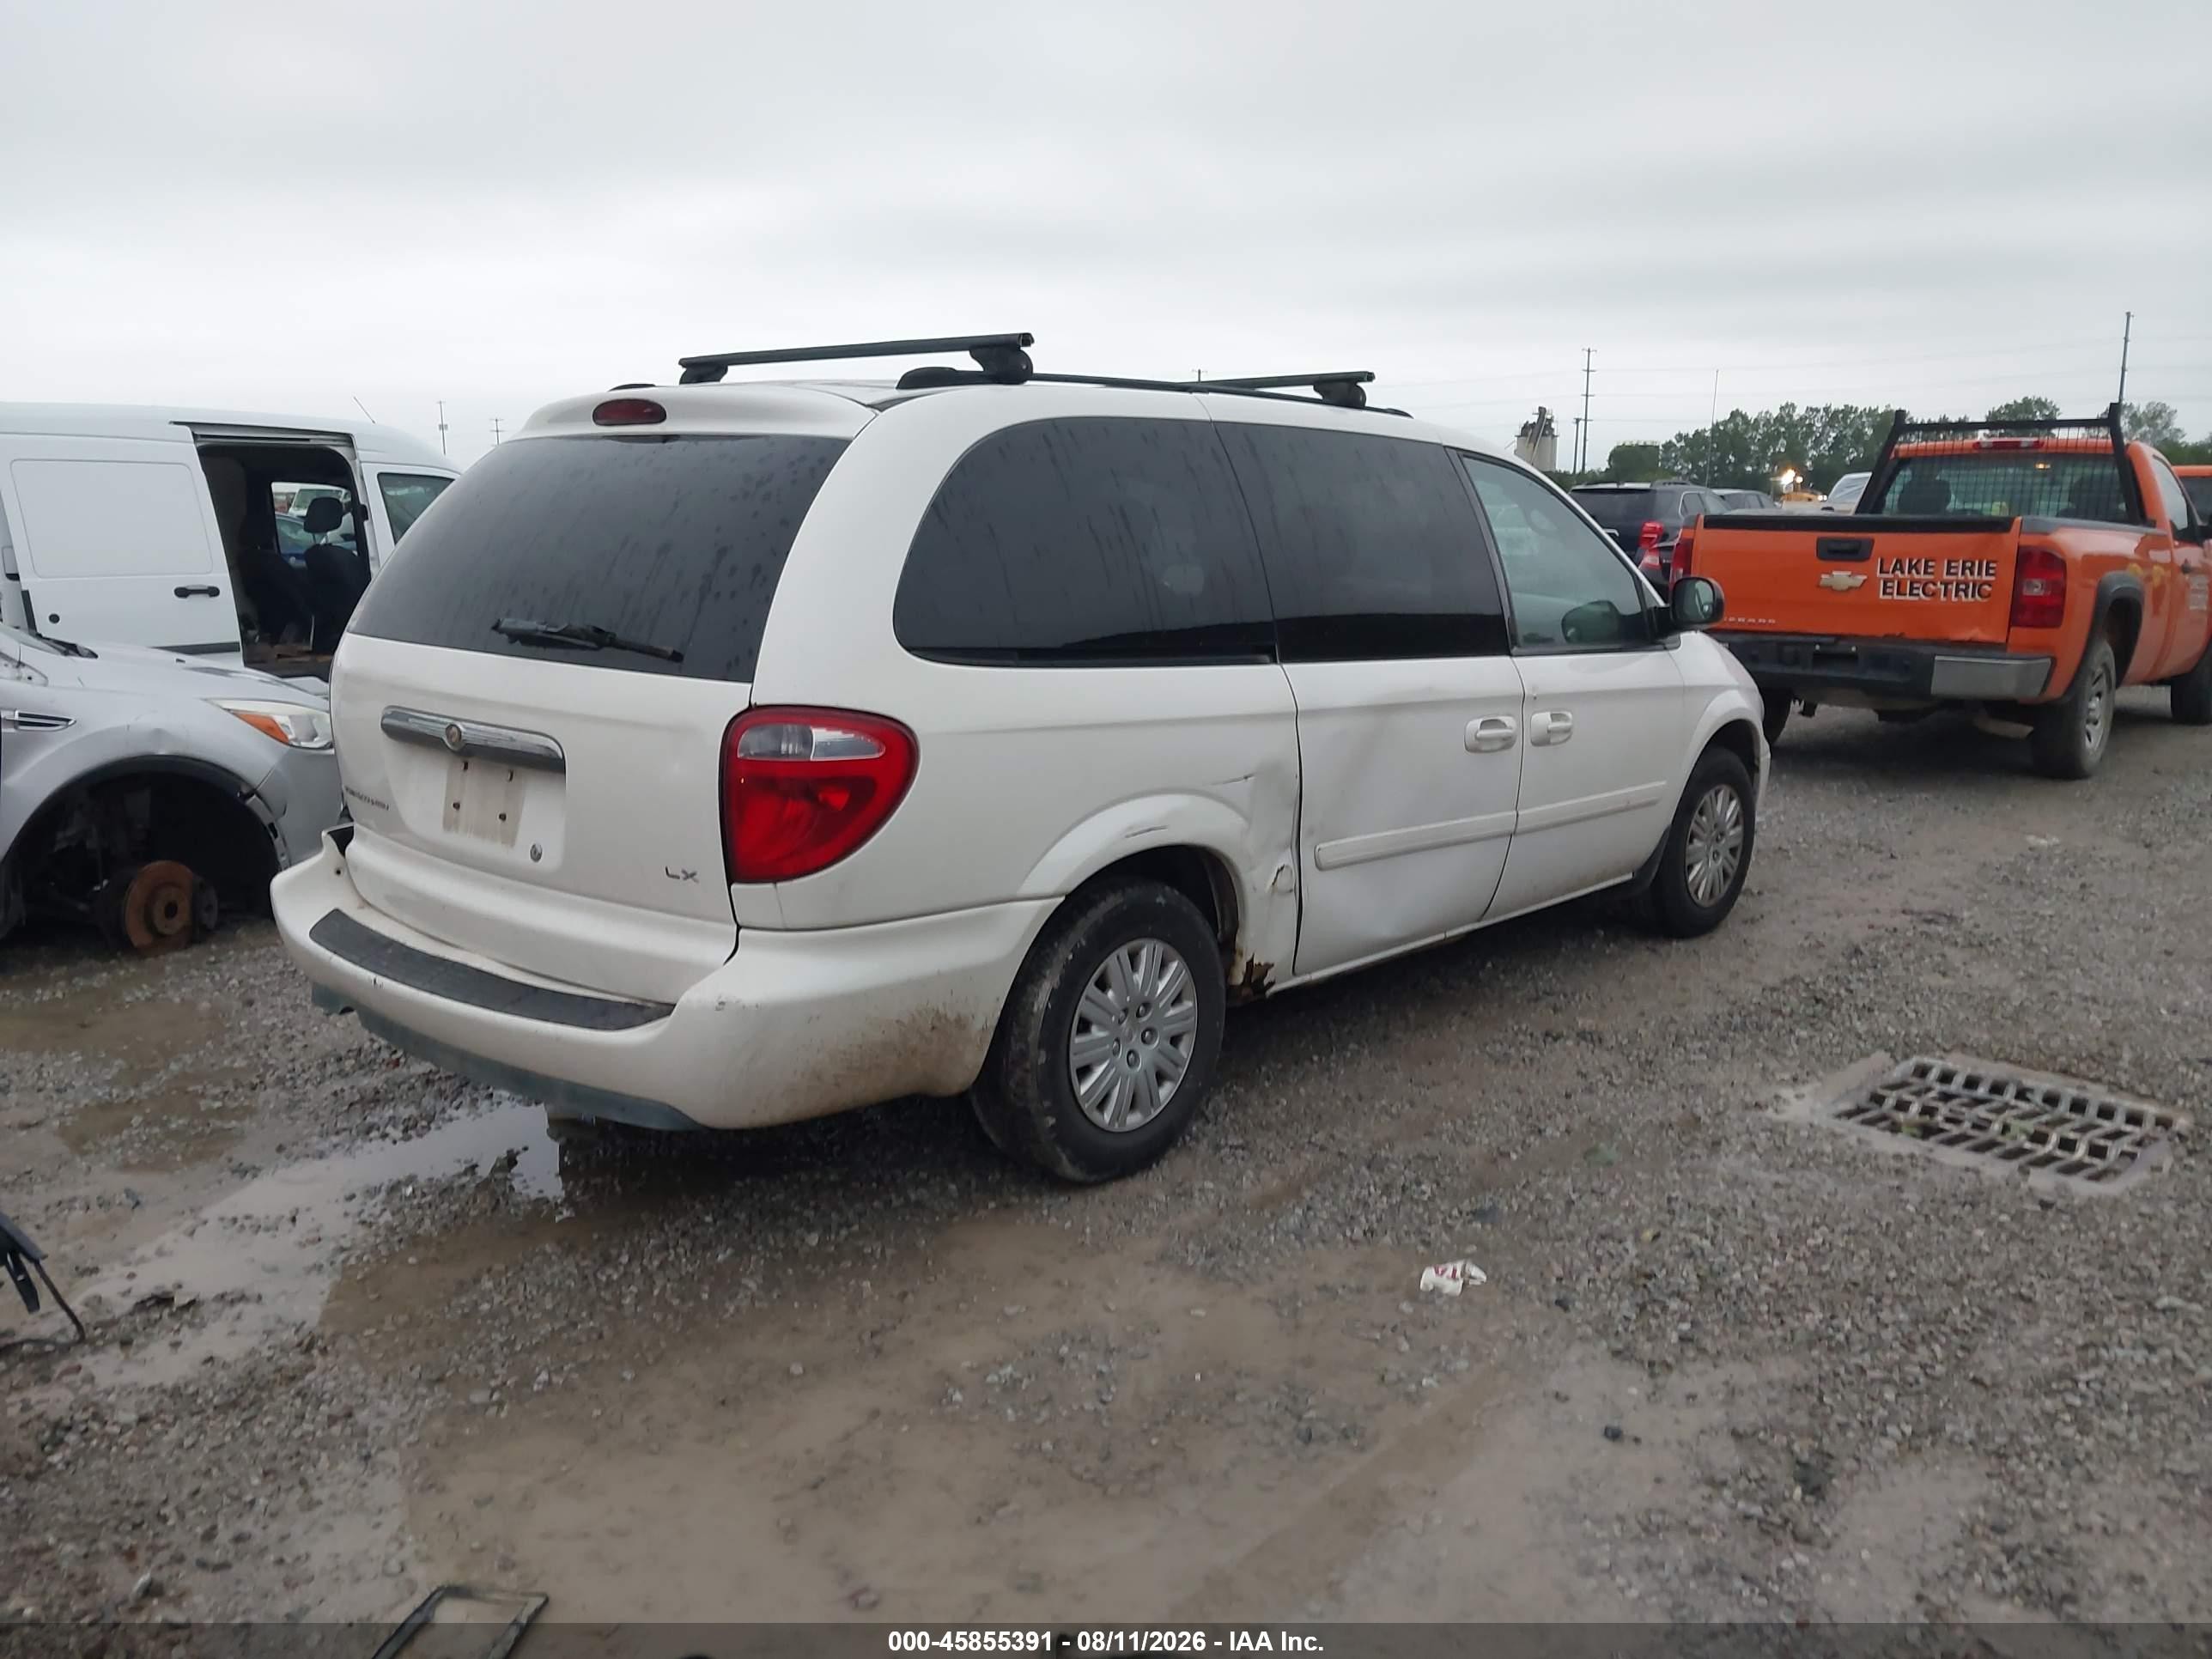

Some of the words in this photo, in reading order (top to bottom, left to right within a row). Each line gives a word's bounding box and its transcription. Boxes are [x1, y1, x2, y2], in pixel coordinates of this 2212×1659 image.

[1876, 557, 1936, 579] LAKE
[1942, 559, 1997, 580] ERIE
[1879, 579, 1993, 602] ELECTRIC
[665, 865, 700, 884] LX
